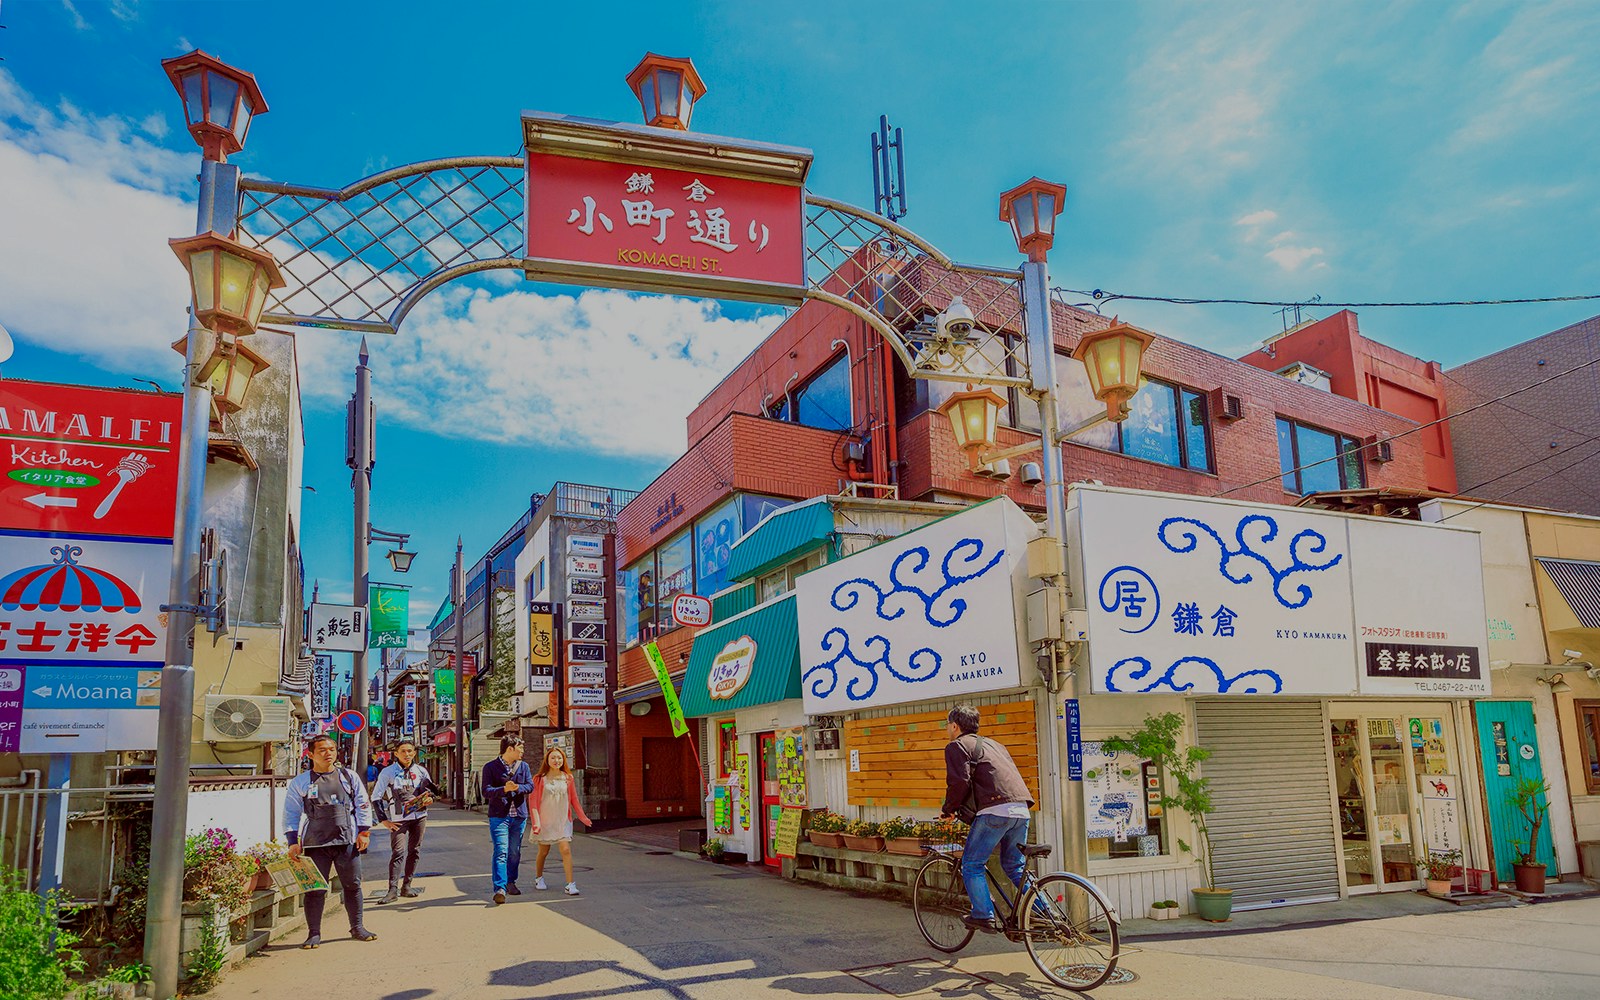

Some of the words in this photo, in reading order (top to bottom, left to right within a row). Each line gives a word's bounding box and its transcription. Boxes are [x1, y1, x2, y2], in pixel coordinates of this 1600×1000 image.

[624, 172, 715, 203] 鎌倉
[567, 196, 770, 253] 小町通り
[617, 248, 697, 271] KOMACHI
[701, 256, 723, 273] ST.
[11, 444, 104, 469] Kitchen
[20, 472, 87, 486] イタリア食堂
[327, 616, 351, 637] 鮨
[683, 615, 703, 624] RIKYU
[1171, 602, 1239, 638] 鎌倉
[1276, 629, 1299, 640] KYO
[1302, 631, 1348, 641] KAMAKURA
[1361, 626, 1401, 638] フォトスタジオ
[960, 652, 986, 667] KYO
[1376, 649, 1471, 673] 登美太郎の店
[536, 667, 550, 675] 1F
[949, 666, 1003, 683] KAMAKURA
[56, 683, 132, 699] Moana
[23, 722, 38, 730] café
[39, 722, 71, 730] vivement
[71, 721, 105, 730] dimanche
[1070, 709, 1079, 750] 小町二丁目
[1070, 753, 1081, 763] 10
